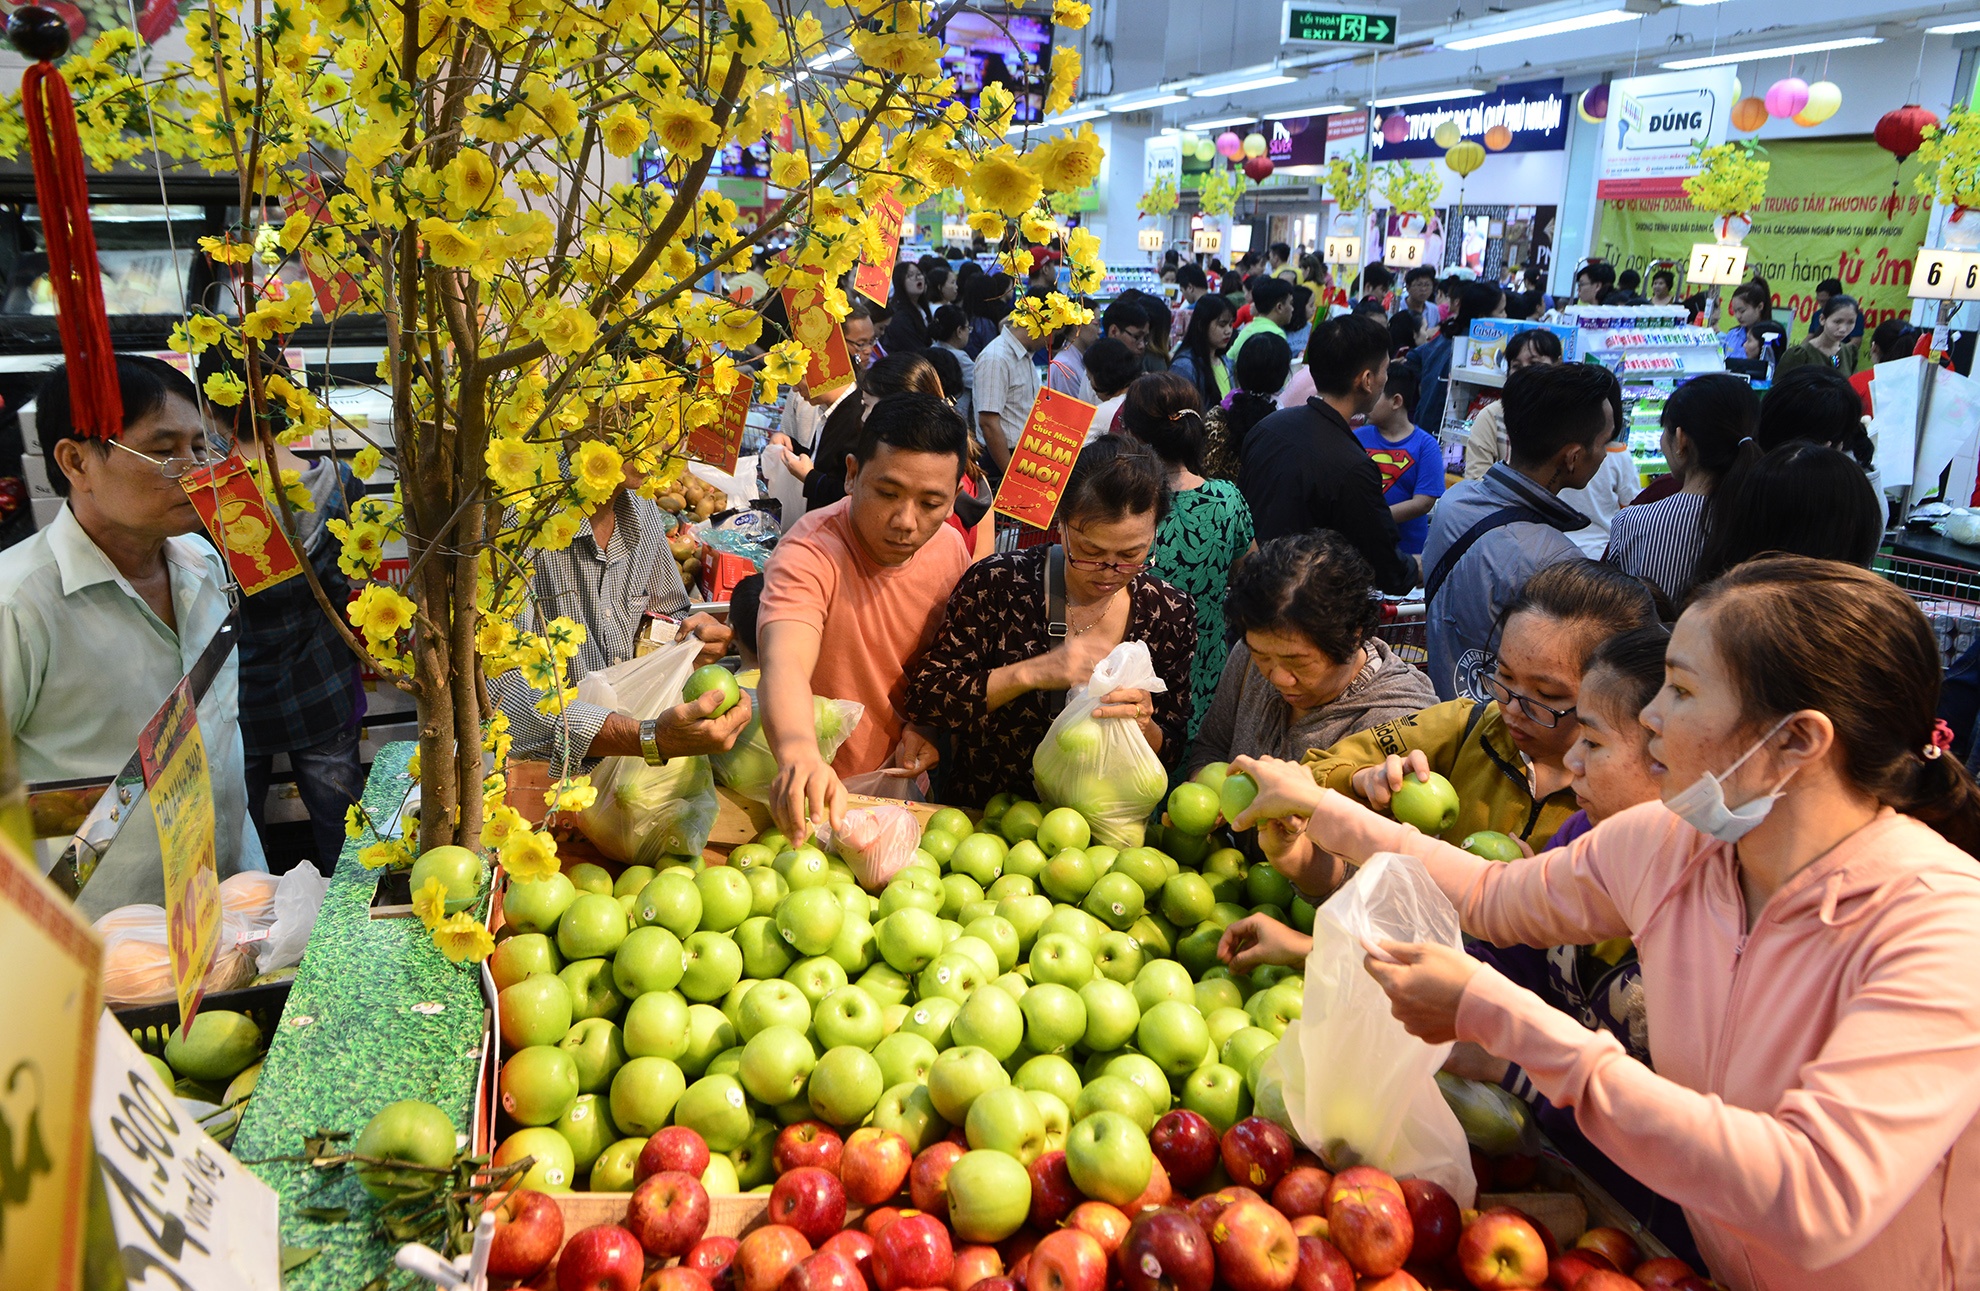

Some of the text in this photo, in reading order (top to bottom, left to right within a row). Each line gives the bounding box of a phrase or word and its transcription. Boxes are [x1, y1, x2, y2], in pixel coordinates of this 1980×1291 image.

[1315, 15, 1340, 26] THOÁT
[1303, 29, 1336, 40] EXIT
[1649, 107, 1702, 132] ĐÚNG
[1663, 197, 1695, 212] DOANH
[1764, 196, 1799, 212] TRUNG
[1150, 236, 1159, 247] 11
[1207, 237, 1217, 248] 10
[1346, 243, 1353, 257] 9
[1390, 245, 1396, 259] 8
[1408, 246, 1416, 260] 8
[1699, 254, 1709, 273] 7
[1726, 257, 1736, 275] 7
[1838, 247, 1865, 285] từ
[1927, 262, 1943, 286] 6
[1966, 264, 1979, 288] 6
[1473, 324, 1503, 338] Custas
[1033, 423, 1078, 448] Chúc Mừng
[1023, 434, 1073, 467] NĂM
[1016, 458, 1061, 487] MỚI
